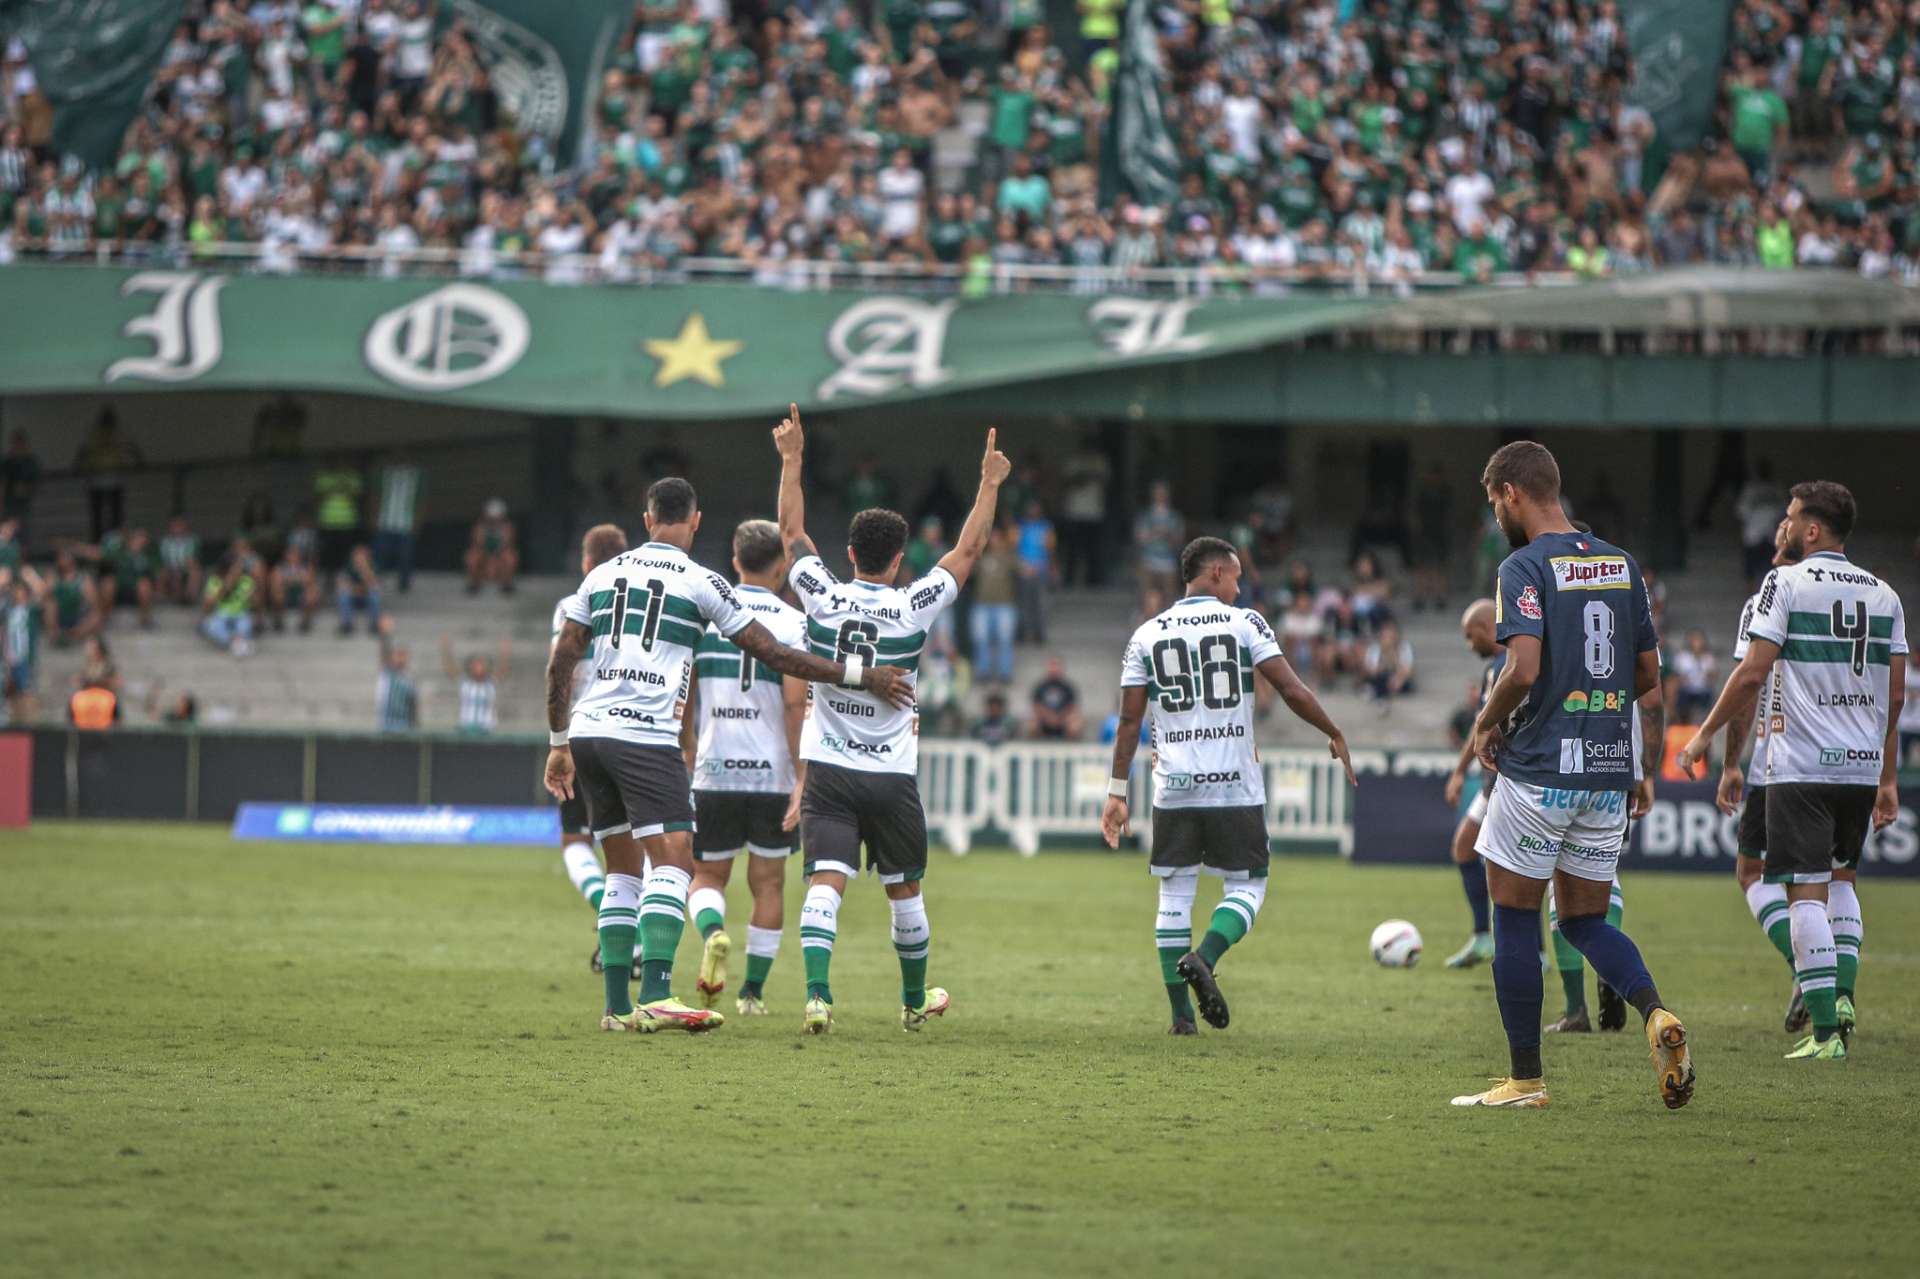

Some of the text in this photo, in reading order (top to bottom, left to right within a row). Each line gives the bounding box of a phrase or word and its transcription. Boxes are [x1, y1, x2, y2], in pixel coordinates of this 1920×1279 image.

[1828, 571, 1879, 587] TEQUALY
[912, 595, 937, 611] TORK
[611, 577, 665, 653] 11
[1177, 613, 1231, 627] TEQUALY
[1584, 600, 1615, 679] 8
[1831, 600, 1868, 678] 4
[1152, 633, 1242, 714] 98
[1589, 689, 1627, 712] B&F
[1771, 673, 1782, 712] Bitci
[1818, 694, 1875, 706] L. CASTAN
[608, 707, 655, 725] COXA
[1165, 723, 1245, 744] IGOR PAIXÃO
[846, 739, 892, 754] COXA
[1823, 749, 1881, 762] TV COXA
[724, 759, 772, 770] COXA
[1169, 771, 1241, 787] TV COXA
